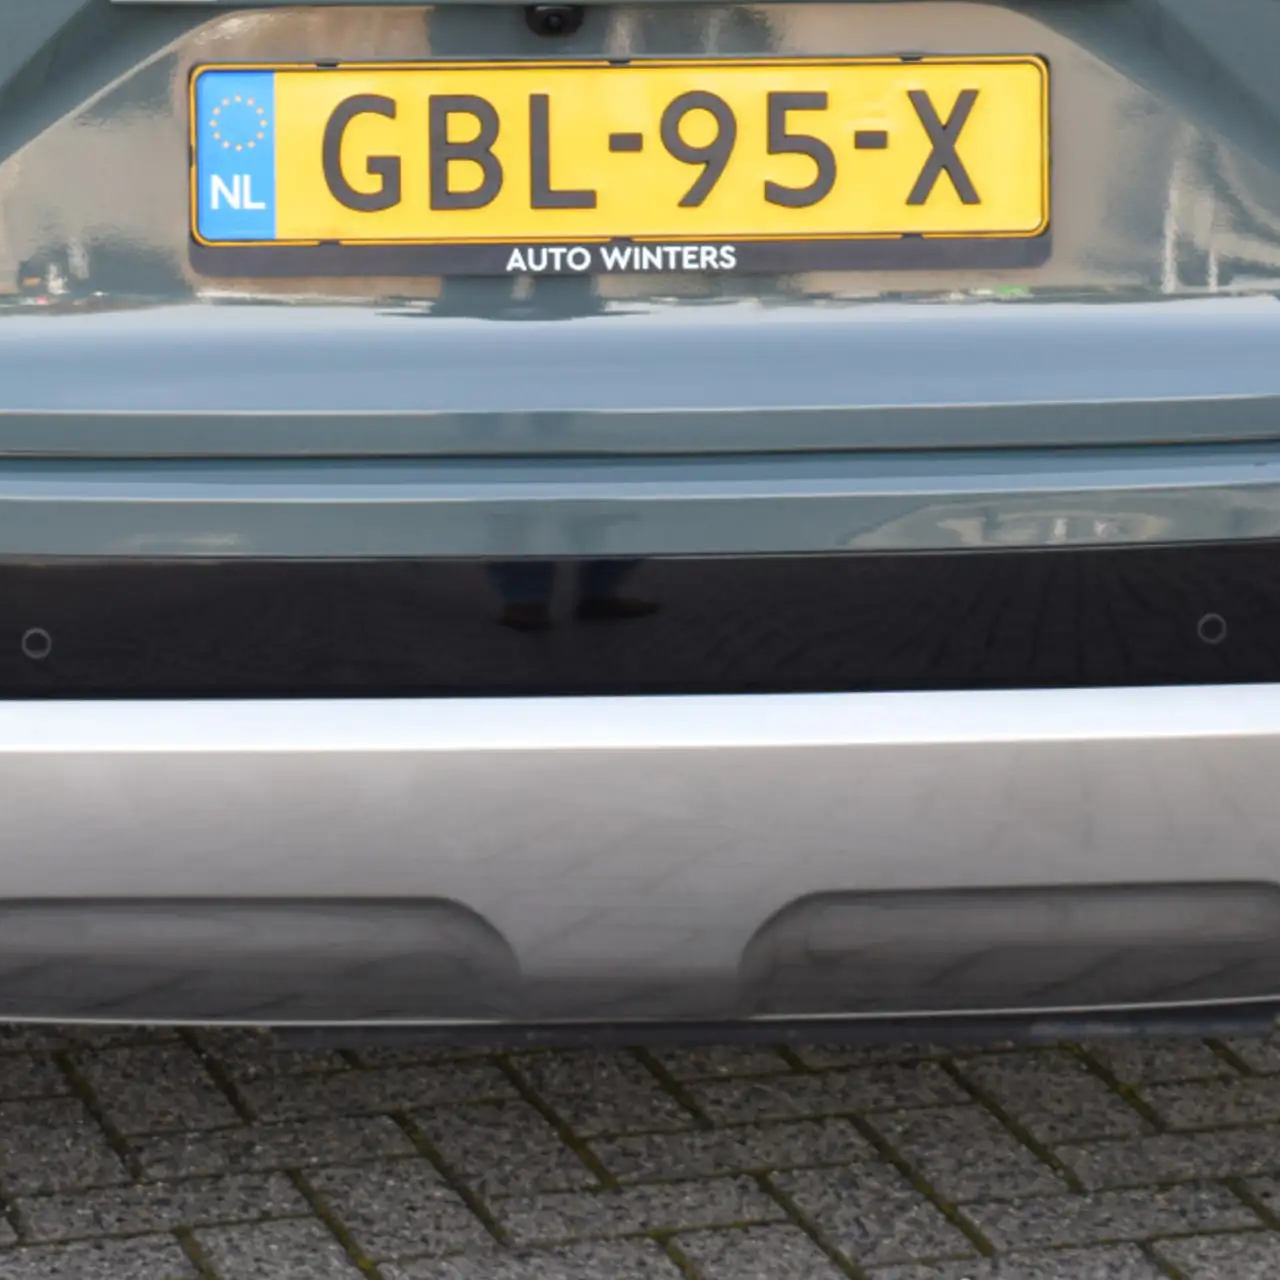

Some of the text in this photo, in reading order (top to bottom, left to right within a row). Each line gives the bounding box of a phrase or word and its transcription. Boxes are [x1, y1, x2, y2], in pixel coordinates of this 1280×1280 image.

[210, 89, 981, 213] NL GBL-95-X
[506, 245, 737, 273] AUTO WINTERS
